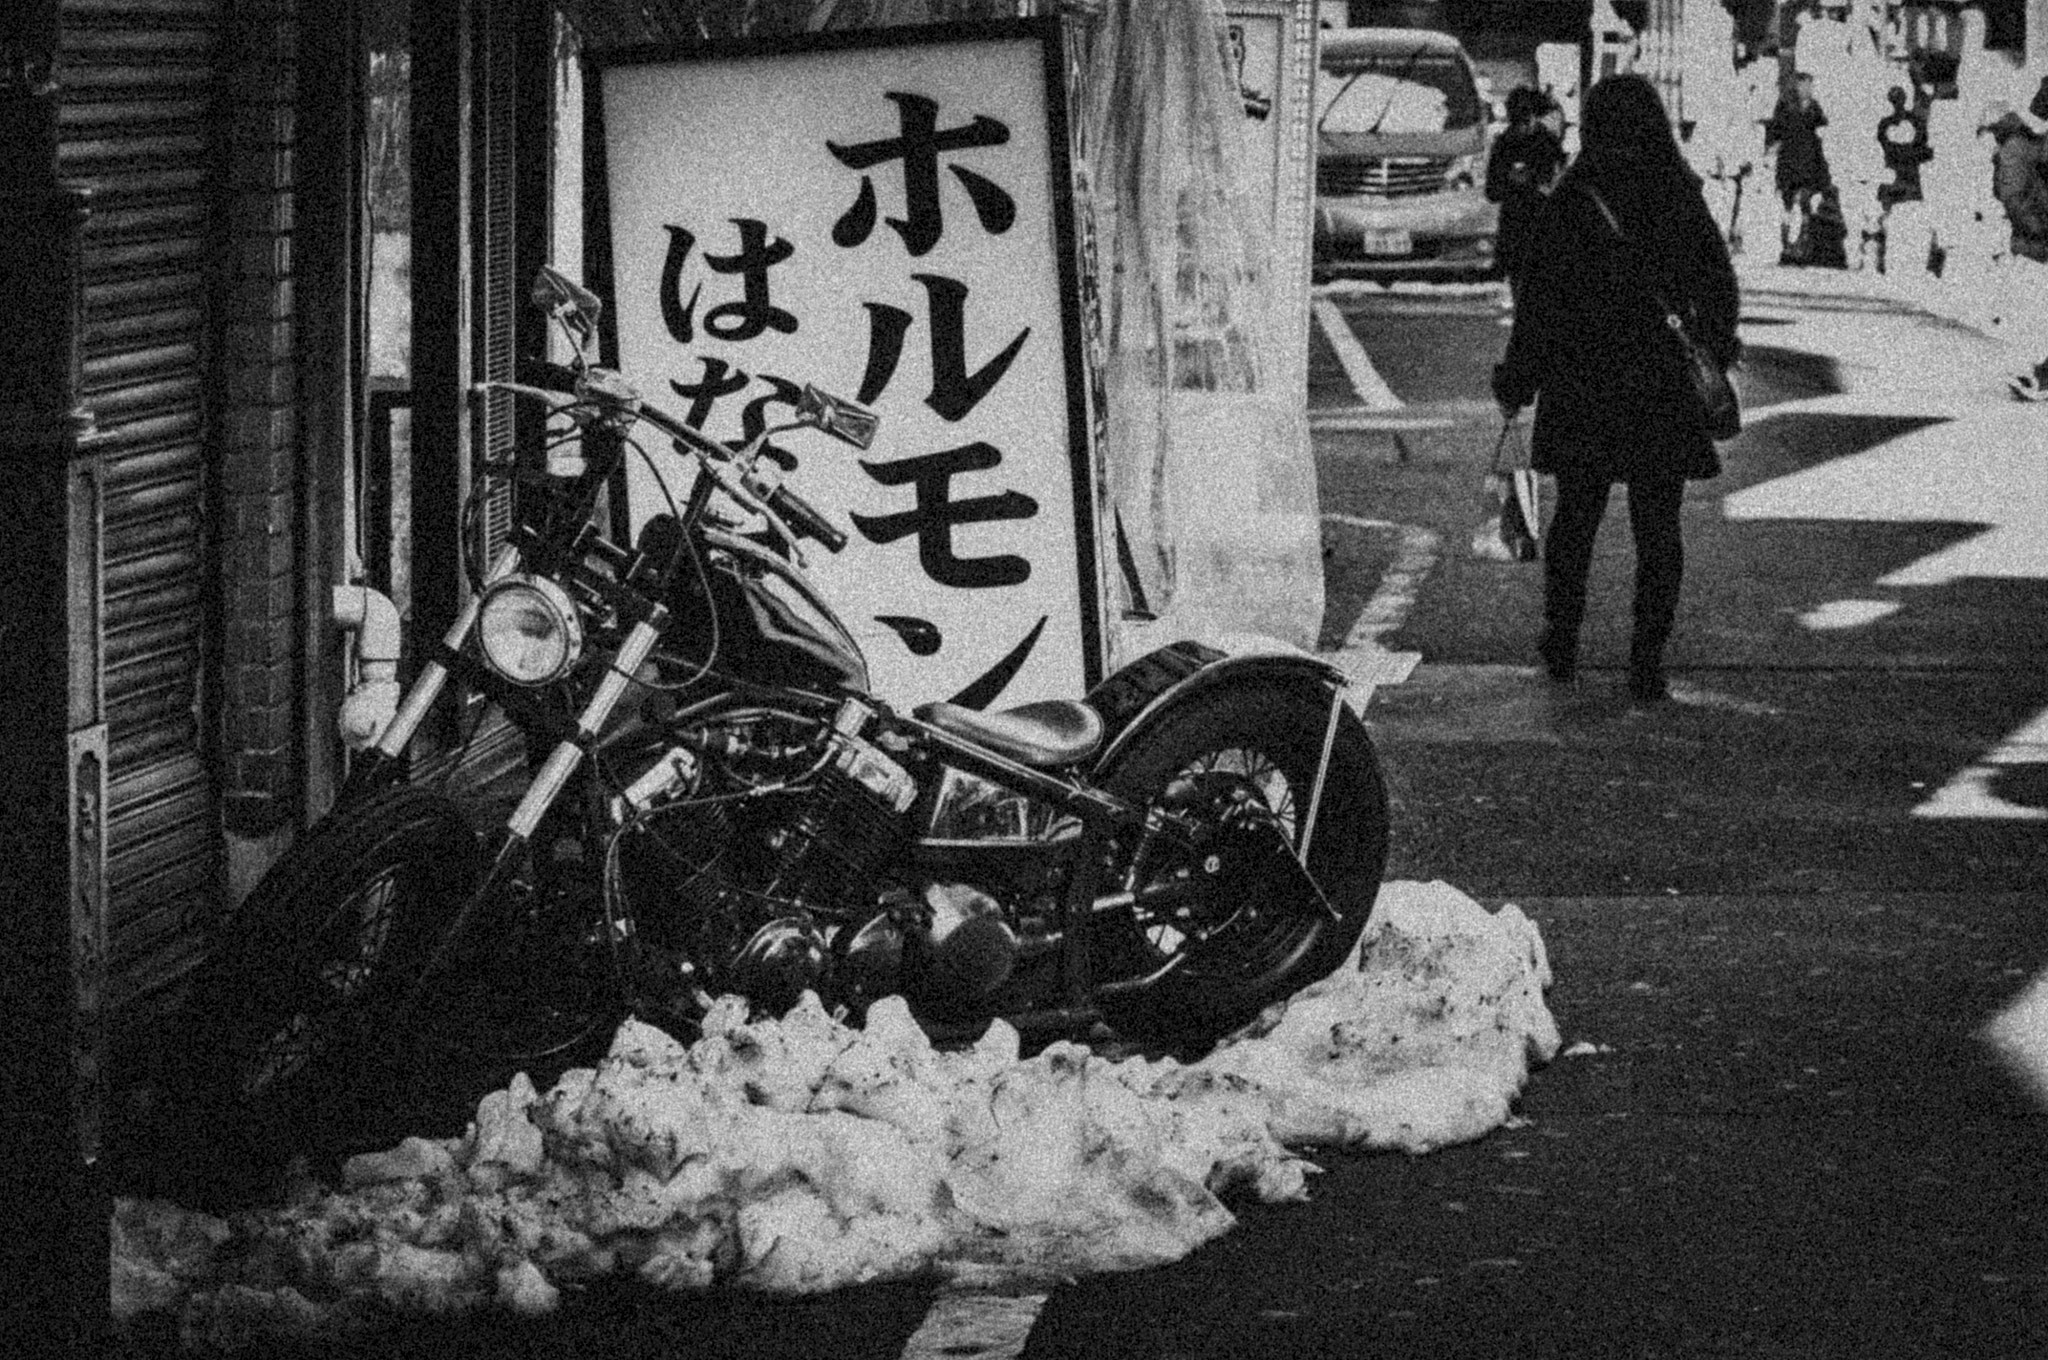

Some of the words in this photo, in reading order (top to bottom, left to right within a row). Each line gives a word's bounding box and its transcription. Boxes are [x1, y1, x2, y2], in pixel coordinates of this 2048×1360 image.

[662, 218, 798, 557] はな
[826, 91, 1048, 711] ホルモン
